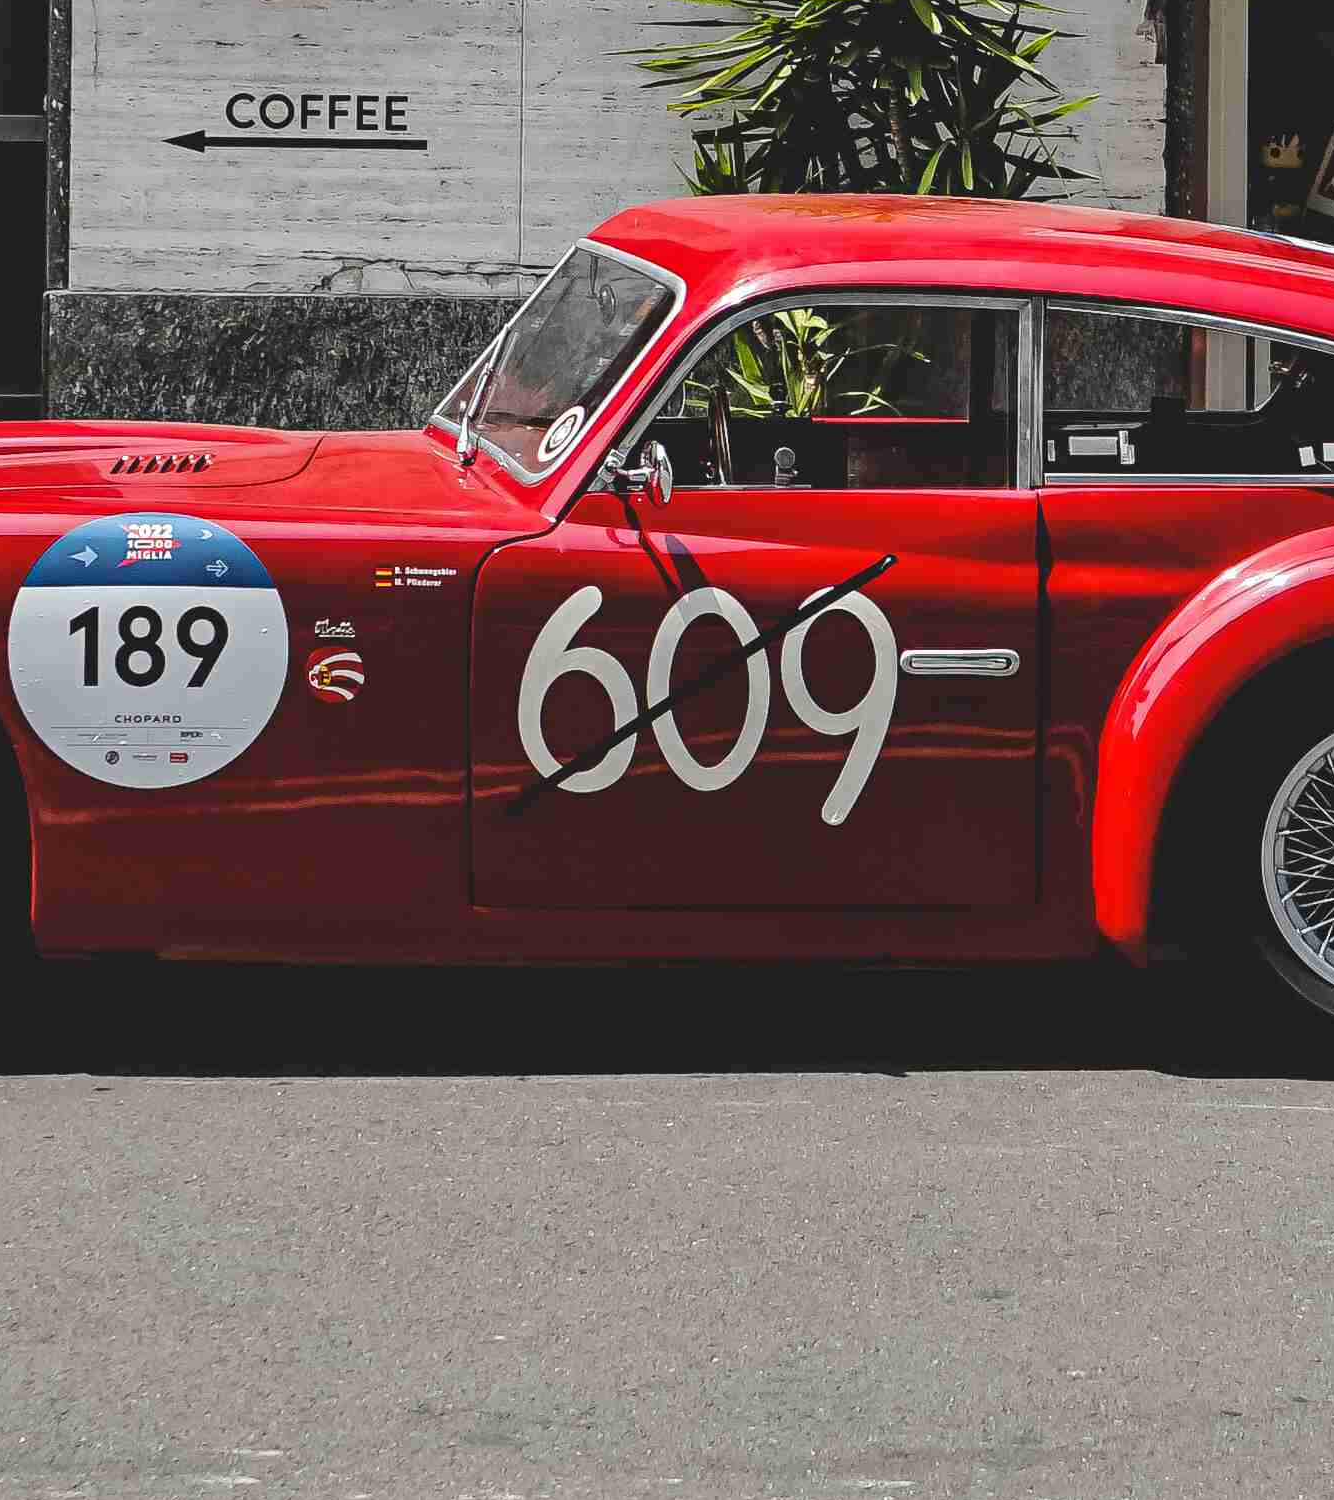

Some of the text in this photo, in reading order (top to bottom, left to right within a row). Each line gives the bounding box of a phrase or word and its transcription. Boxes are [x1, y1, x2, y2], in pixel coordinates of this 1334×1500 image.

[225, 92, 409, 131] COFFEE
[127, 523, 173, 539] 2022
[127, 551, 173, 560] MIGLIA
[69, 605, 229, 688] 189
[518, 585, 898, 825] 609
[114, 715, 182, 724] CHOPARD
